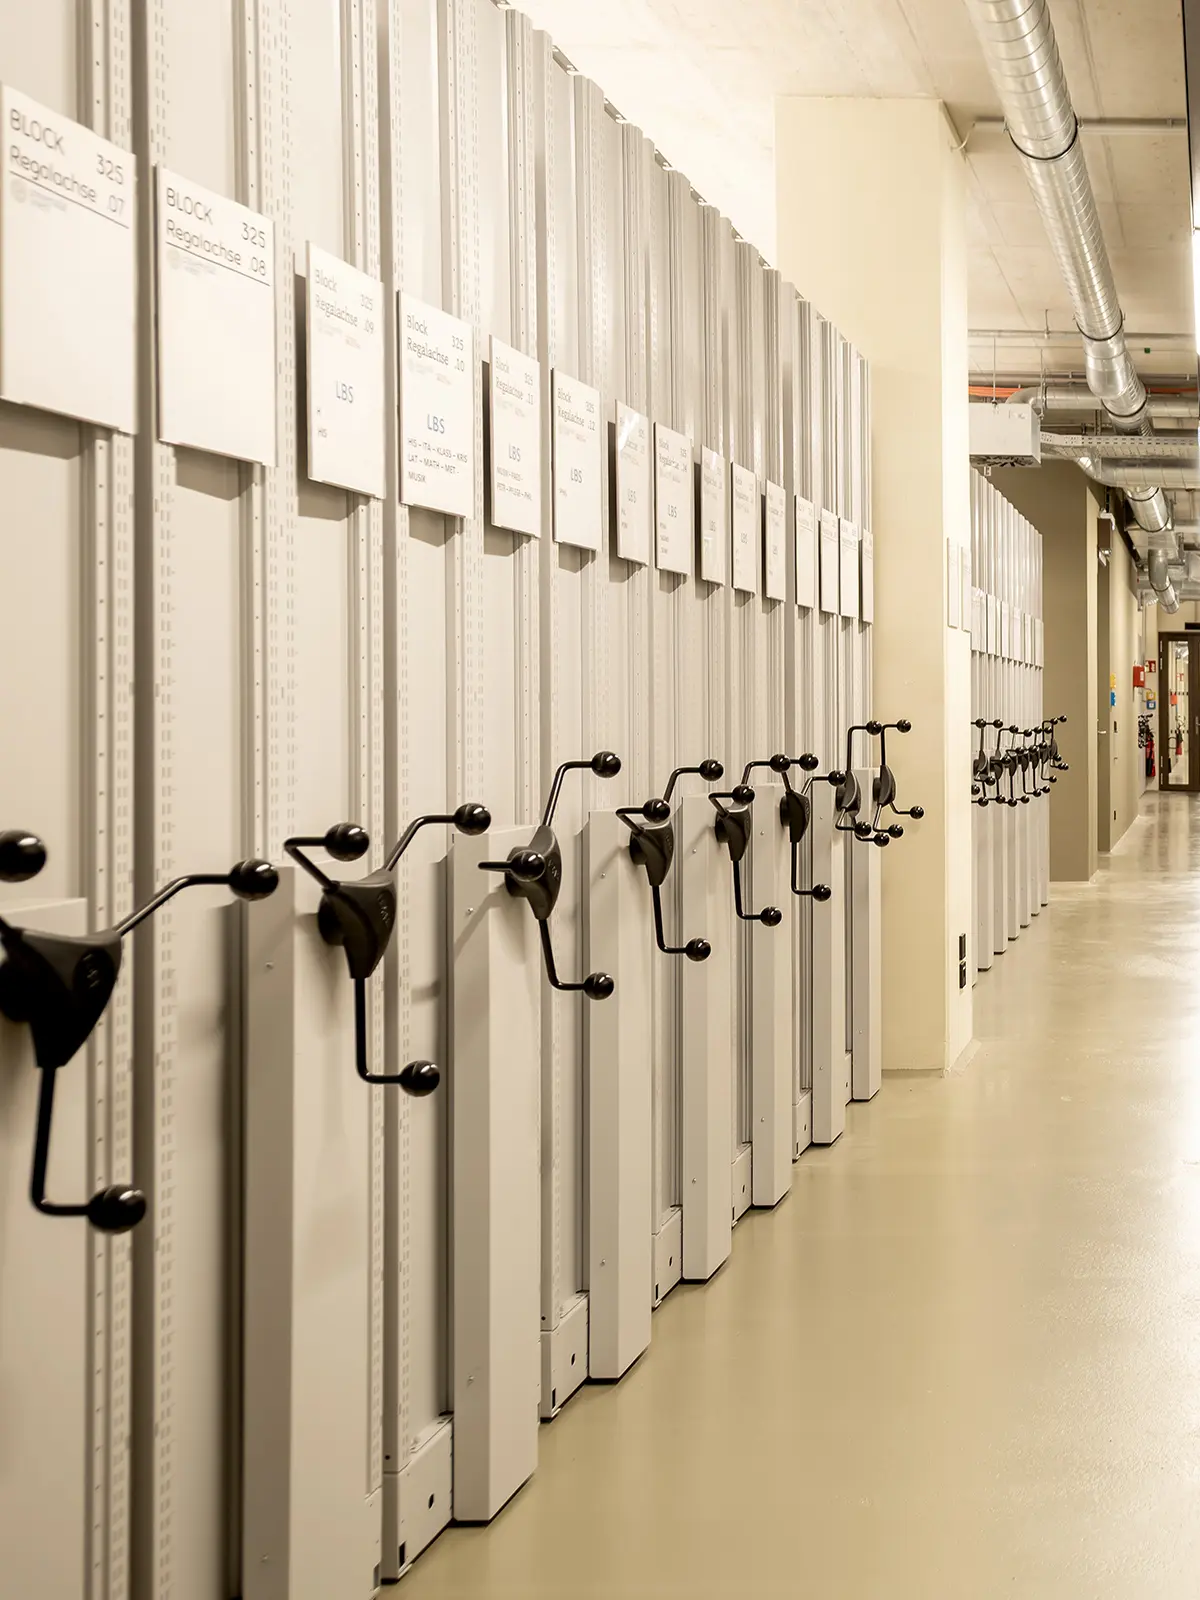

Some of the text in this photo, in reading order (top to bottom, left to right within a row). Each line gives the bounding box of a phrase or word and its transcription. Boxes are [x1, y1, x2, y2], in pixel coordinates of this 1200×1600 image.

[10, 108, 124, 185] BLOCK 325
[10, 144, 97, 203] Regalachse
[166, 187, 266, 249] BLOCK 325
[166, 218, 241, 266] Regalachse
[314, 269, 374, 311] Block 325
[315, 293, 358, 327] Regalachse
[406, 313, 464, 351] Block 325
[406, 336, 449, 366] Regalachse
[335, 379, 353, 404] LBS
[427, 413, 445, 434] LBS
[508, 442, 521, 462] LBS
[570, 466, 583, 484] LBS
